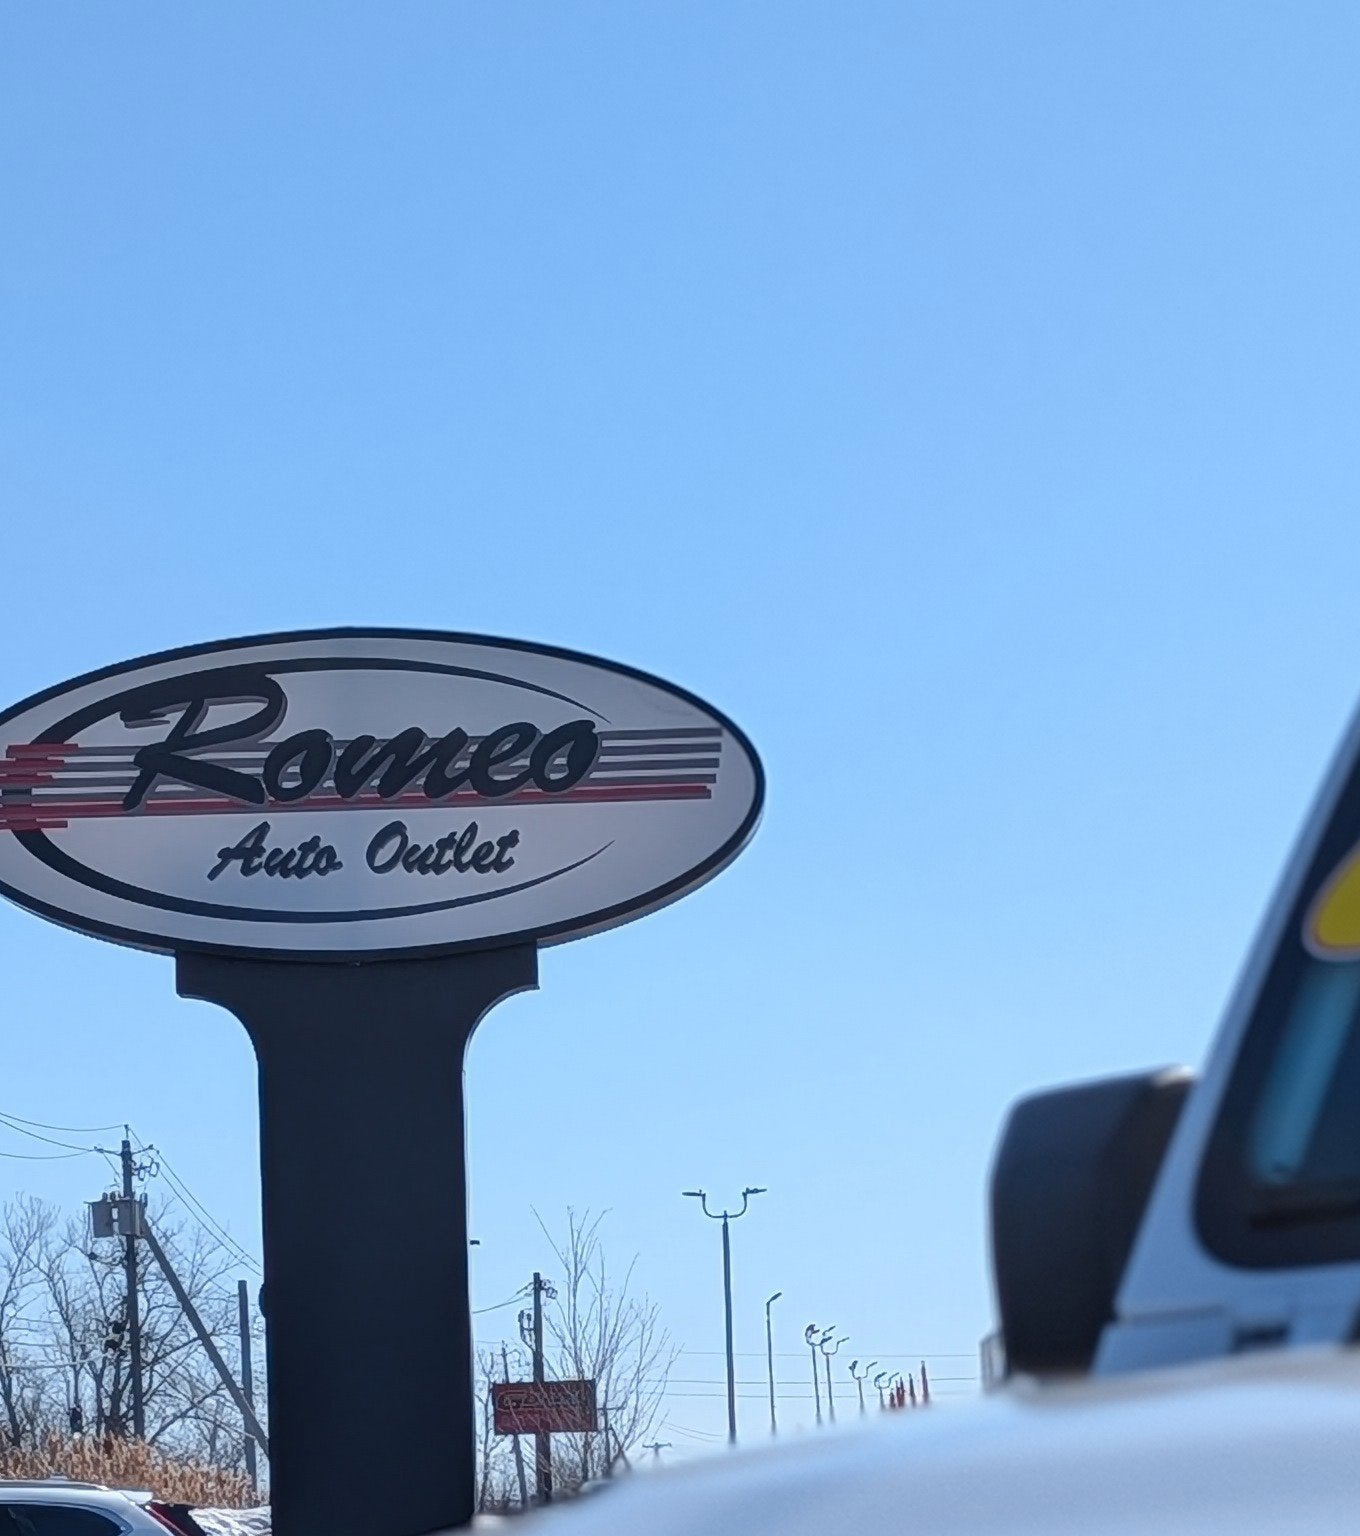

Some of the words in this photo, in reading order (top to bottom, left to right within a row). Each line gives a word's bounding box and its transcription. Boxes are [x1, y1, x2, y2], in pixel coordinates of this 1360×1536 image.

[120, 671, 602, 812] Romeo
[207, 821, 343, 882] Auto
[365, 820, 520, 877] Outlet
